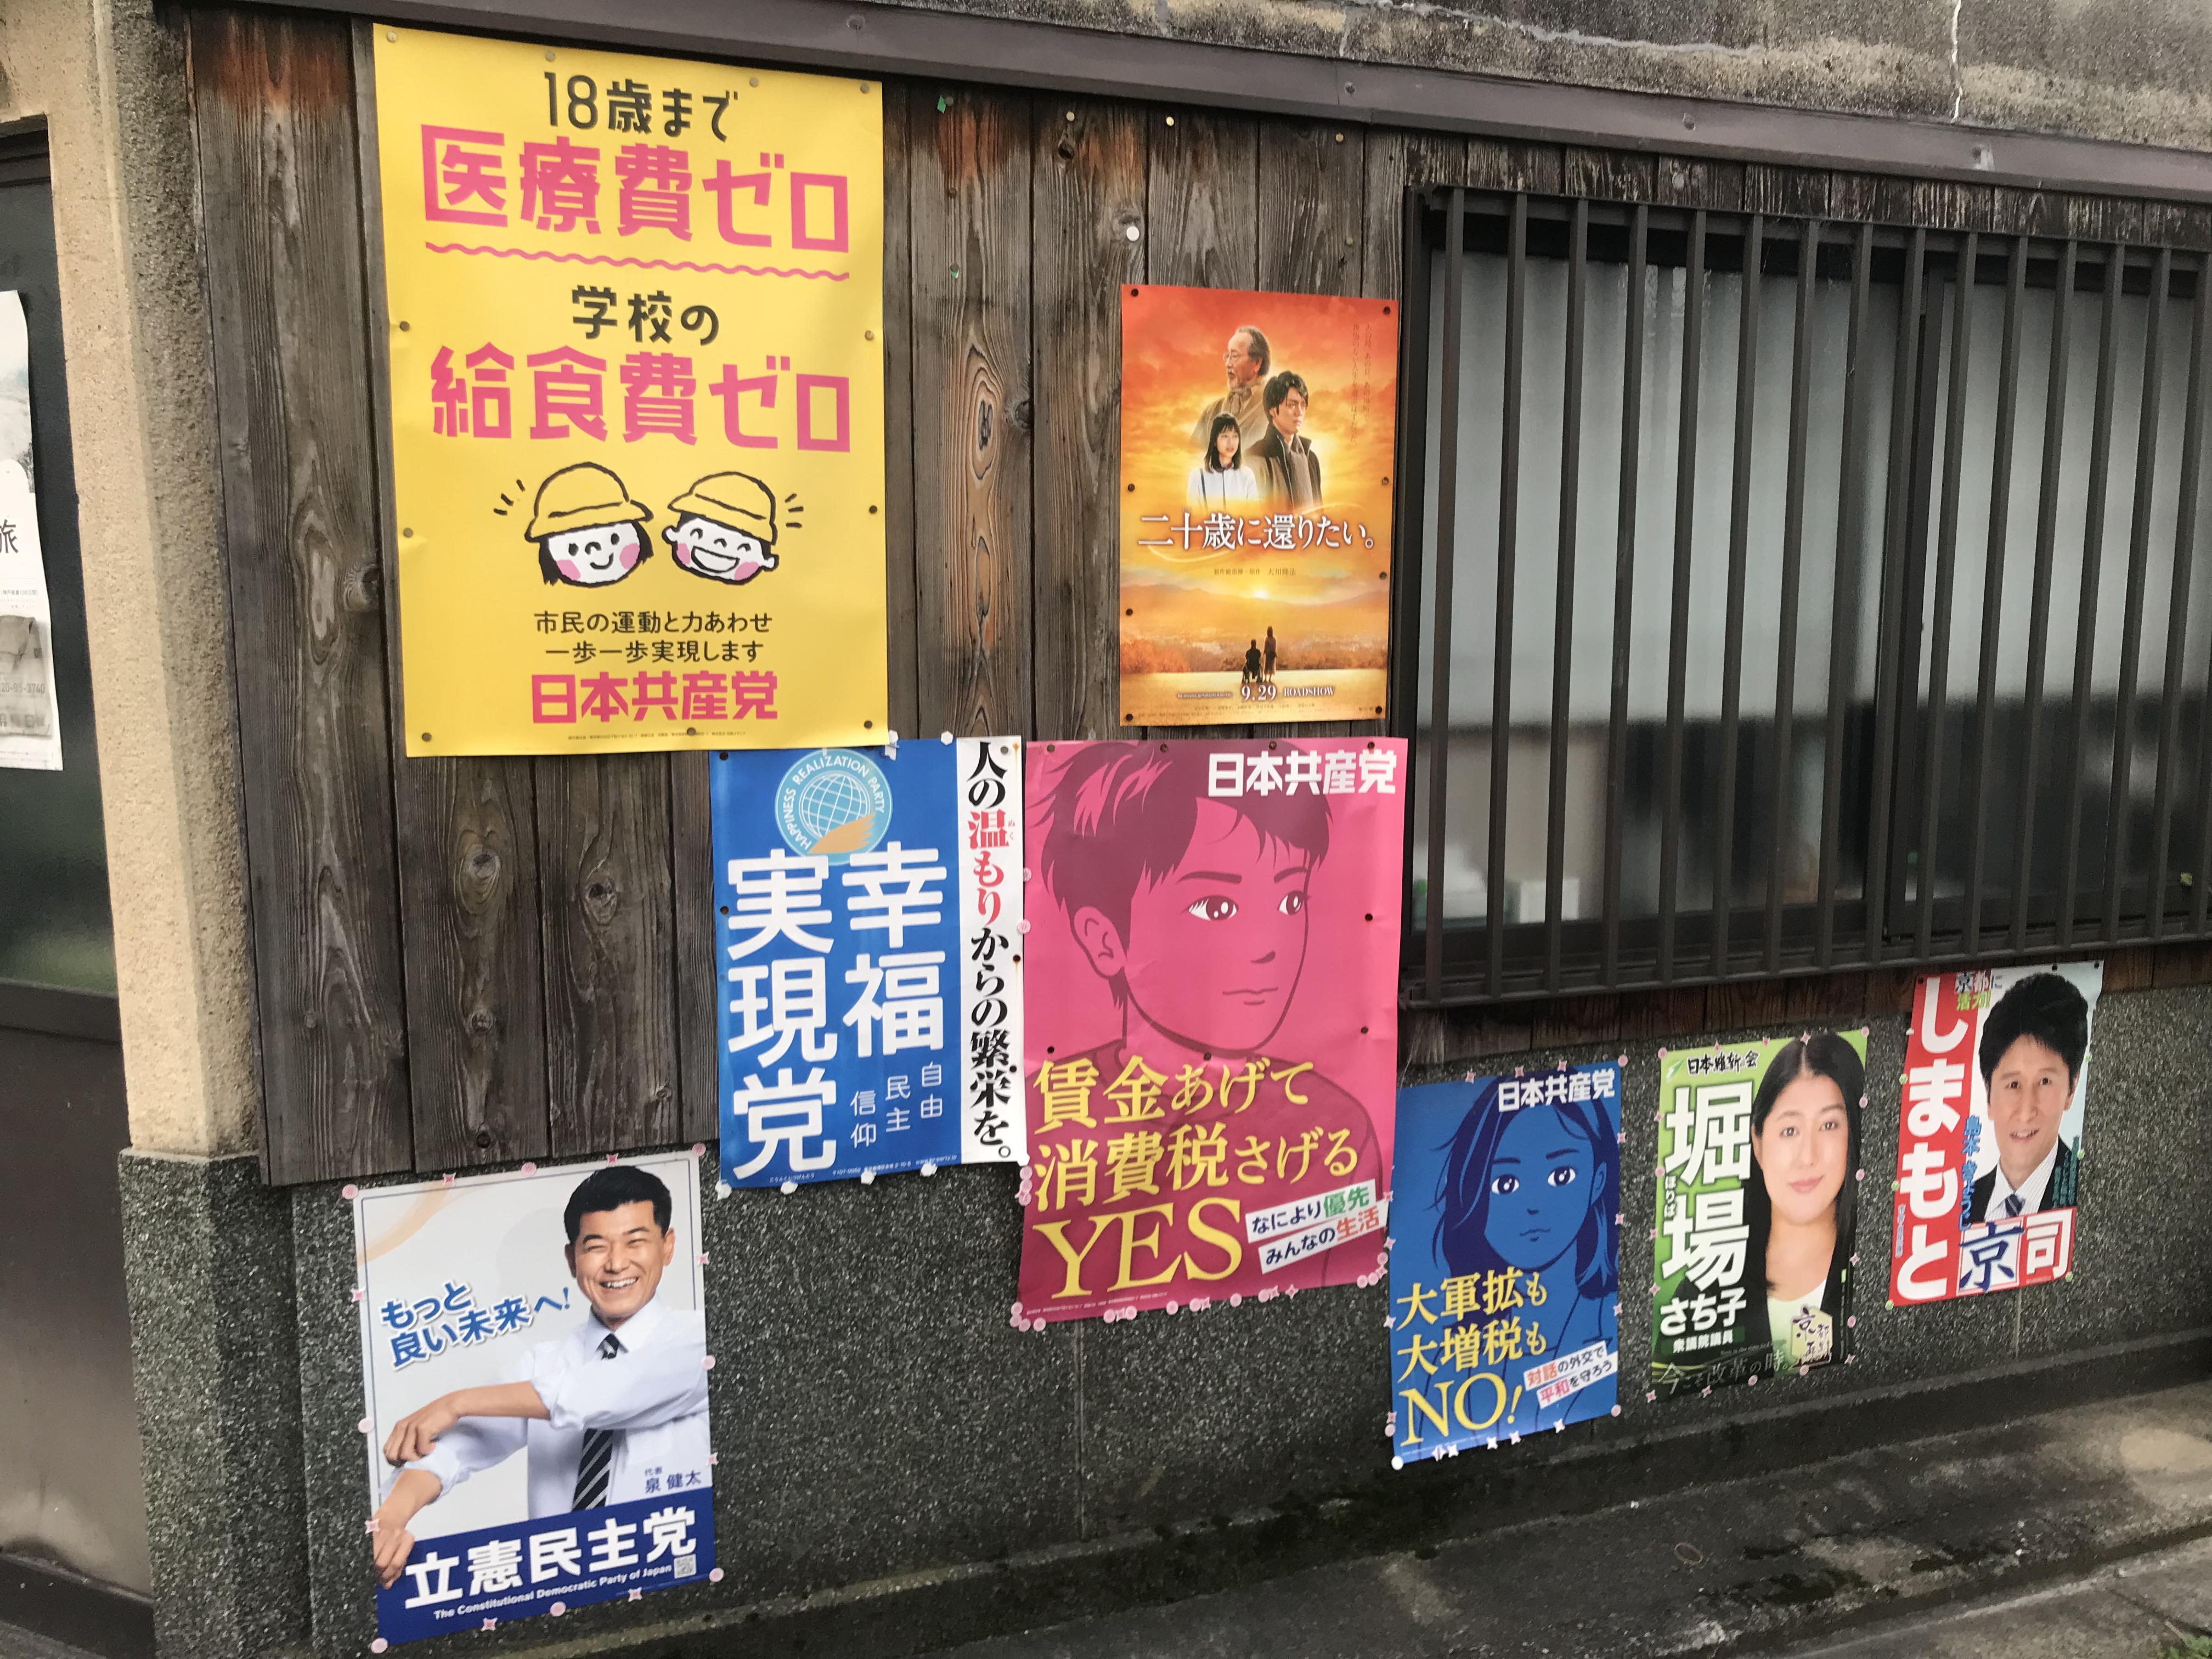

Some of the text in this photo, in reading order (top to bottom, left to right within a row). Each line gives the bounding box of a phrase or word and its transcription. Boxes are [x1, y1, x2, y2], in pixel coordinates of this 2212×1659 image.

[543, 71, 738, 142] 18歳まで
[421, 124, 850, 253] 医療費ゼロ
[571, 284, 719, 346] 学校の
[431, 341, 851, 453] 給食費ゼロ
[1138, 512, 1373, 549] 二十歳に還りたい。
[534, 611, 772, 634] 市民の運動と力あわせ
[546, 639, 764, 664] 一歩一歩実現します
[531, 670, 777, 724] 日本共産党
[1241, 685, 1277, 701] 9.29
[1283, 686, 1335, 697] ROADSHOW
[783, 755, 885, 850] HAPPINESS REALIZATION PARTY
[1208, 749, 1398, 798] 日本共産党
[842, 842, 947, 1058] 幸福
[966, 741, 1011, 1158] 人の温もりからの繁栄を。
[727, 849, 838, 1180] 実現党
[850, 1090, 877, 1148] 信仰
[885, 1075, 911, 1133] 民主
[921, 1062, 943, 1119] 自由
[1032, 1054, 1314, 1134] 賃金あげて
[1498, 1068, 1615, 1113] 日本共産党
[1034, 1122, 1358, 1212] 消費税さげる
[1897, 977, 1969, 1301] しまもと
[1251, 1186, 1370, 1233] なにより優先
[1662, 1081, 1753, 1291] 堀場
[1663, 1175, 1677, 1218] ほりば
[1032, 1198, 1243, 1300] YES
[1265, 1206, 1381, 1265] みんなの生活
[1959, 1208, 2073, 1293] 京司
[381, 1282, 472, 1329] もっと
[1396, 1266, 1548, 1331] 大軍拡も
[1660, 1288, 1747, 1336] さち子
[1397, 1316, 1547, 1383] 大増税も
[1527, 1346, 1605, 1385] 対話の外交で
[1398, 1373, 1523, 1447] NO!
[1539, 1360, 1612, 1403] 平和を守ろう
[405, 1506, 697, 1609] 立憲民主党
[434, 1609, 455, 1621] The
[458, 1591, 534, 1615] Constitutional
[536, 1580, 597, 1599] Democratic
[599, 1572, 627, 1587] Party
[629, 1569, 640, 1581] of
[642, 1564, 672, 1577] Japan
